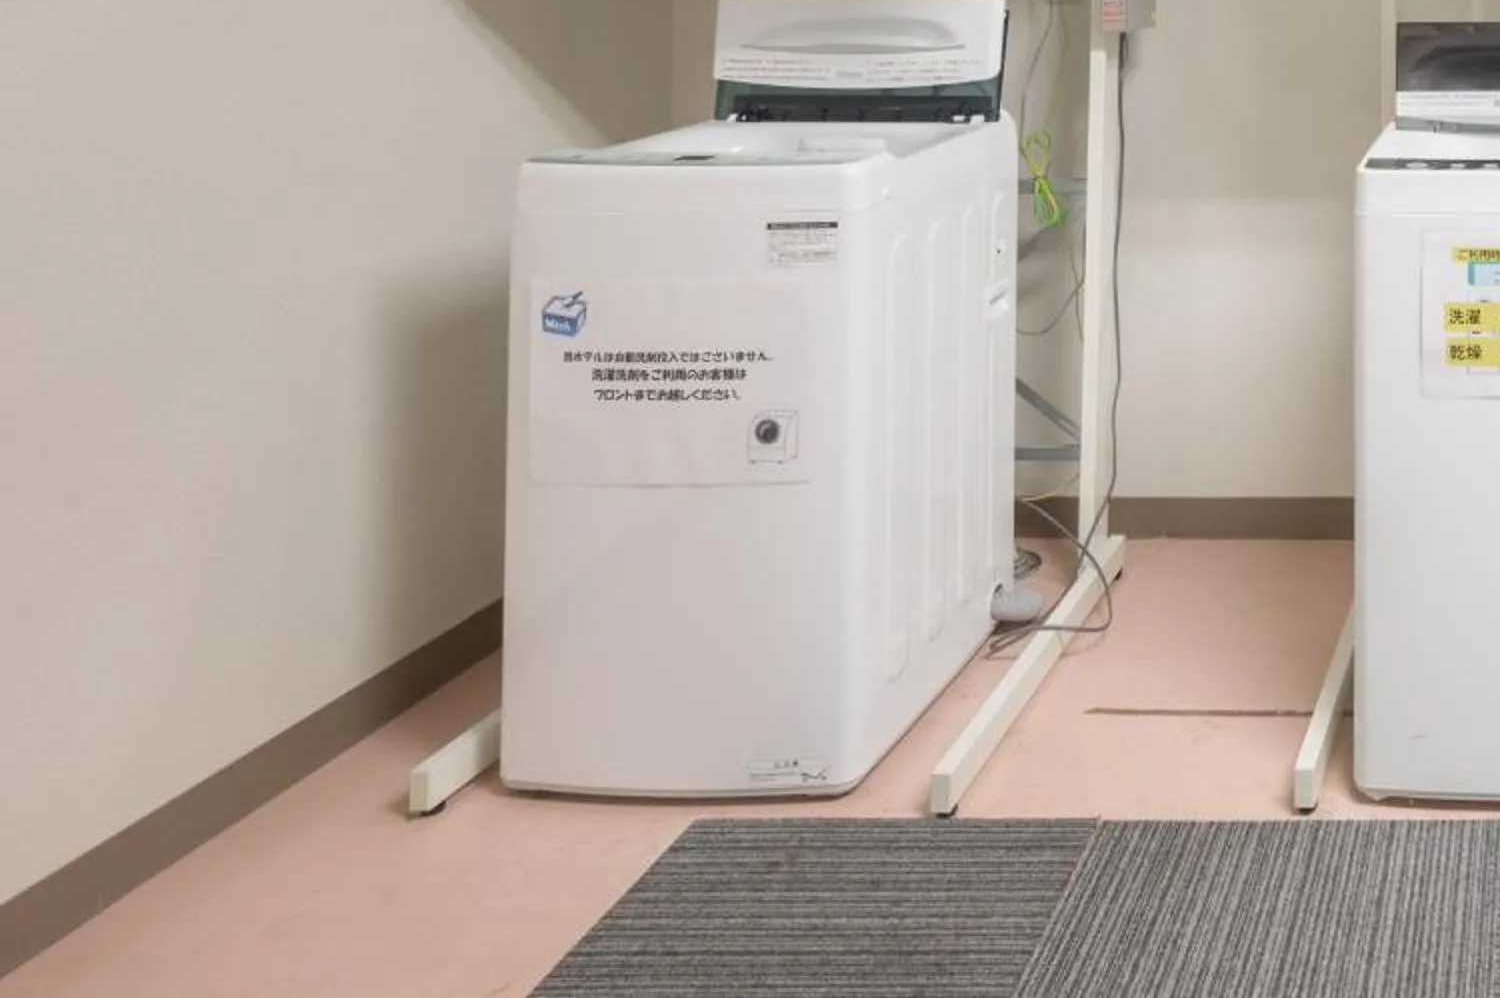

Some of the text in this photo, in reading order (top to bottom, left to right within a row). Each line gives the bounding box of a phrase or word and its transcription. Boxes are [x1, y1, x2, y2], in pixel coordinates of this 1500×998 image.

[1449, 309, 1482, 326] 洗濯
[1450, 344, 1483, 361] 乾燥
[591, 368, 747, 381] 洗濯洗剤をご利用のお客様は
[593, 388, 741, 401] フロントまでお越しください。
